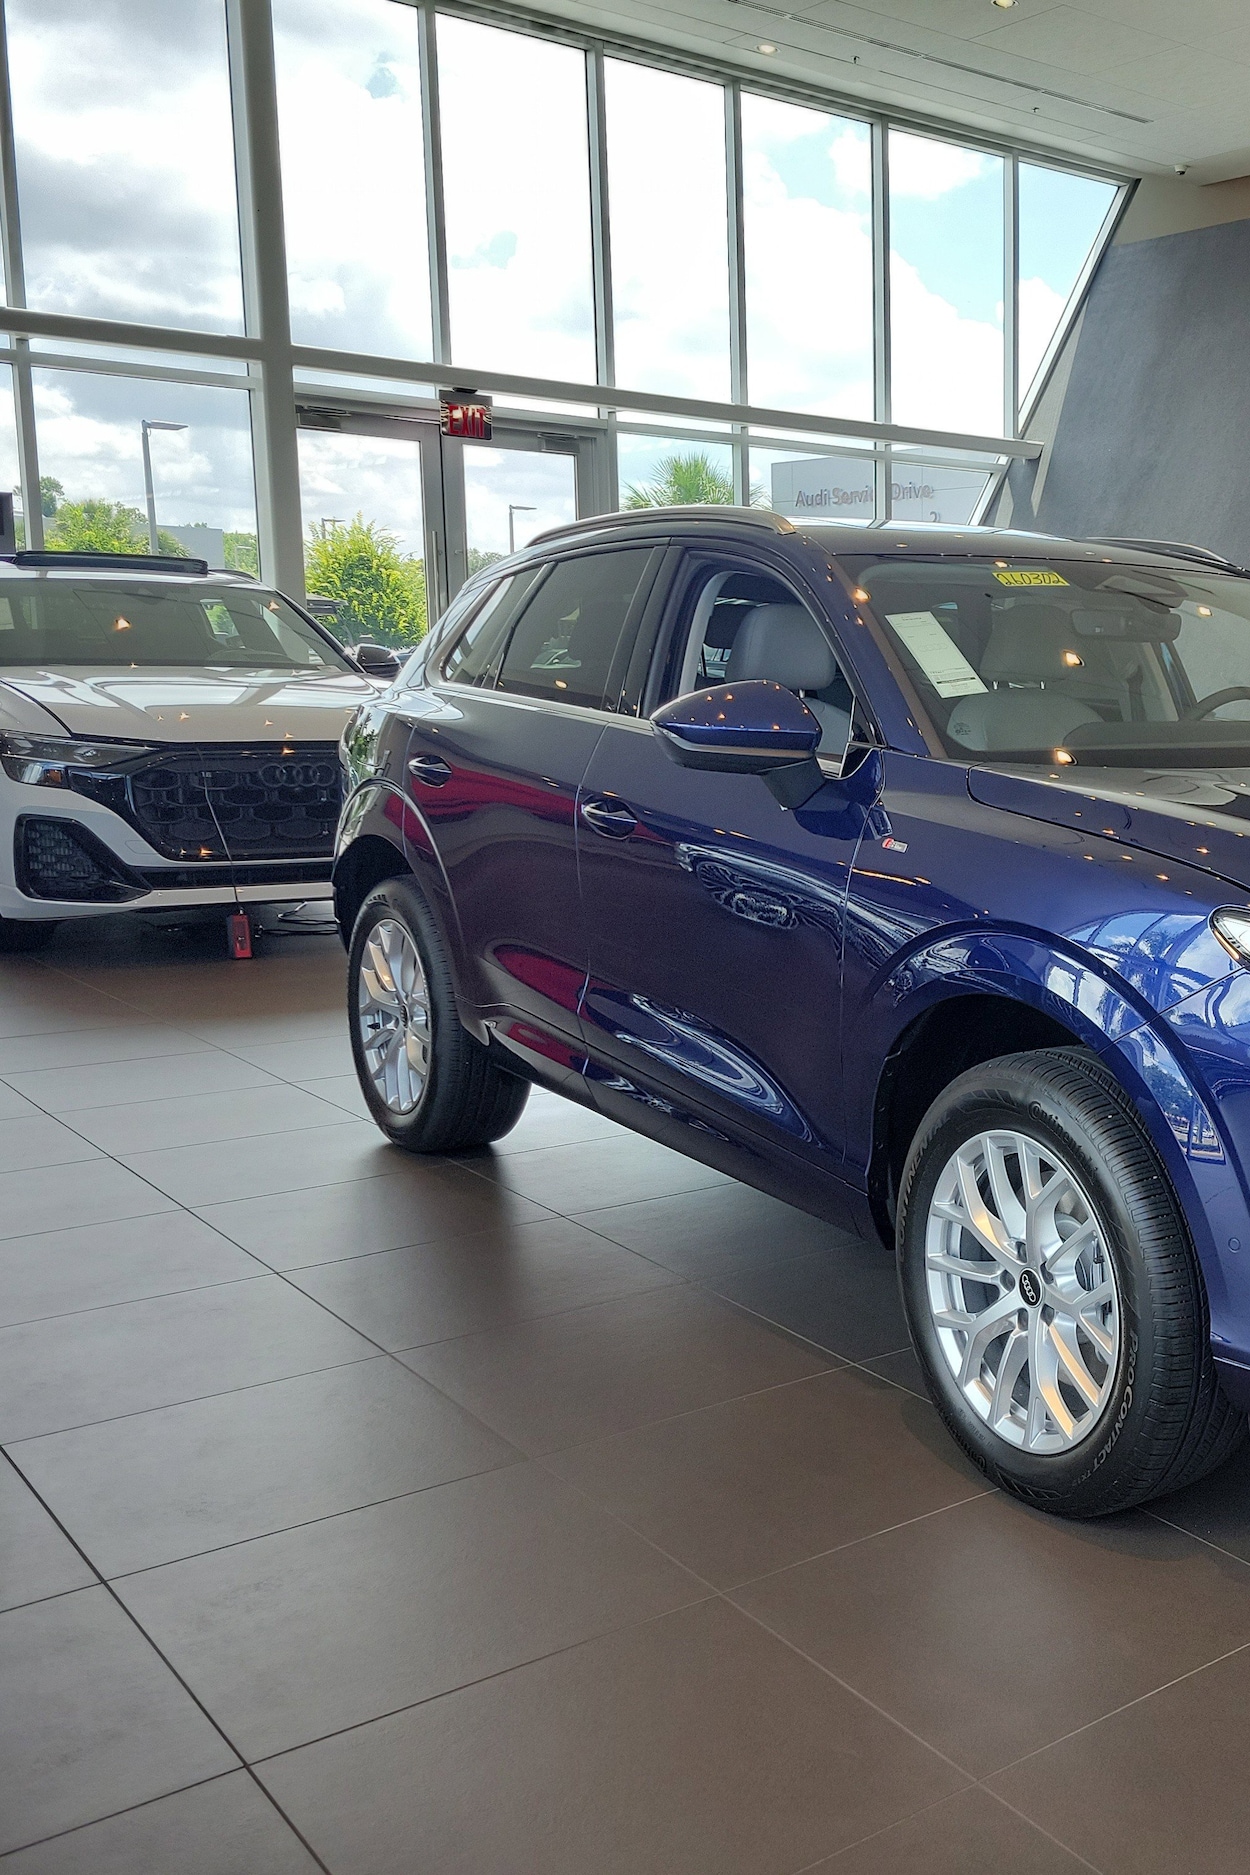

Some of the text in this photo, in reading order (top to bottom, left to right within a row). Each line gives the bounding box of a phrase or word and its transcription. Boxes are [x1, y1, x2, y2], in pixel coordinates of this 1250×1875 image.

[448, 404, 486, 438] EXIT
[795, 482, 932, 507] Audi Servi Drive
